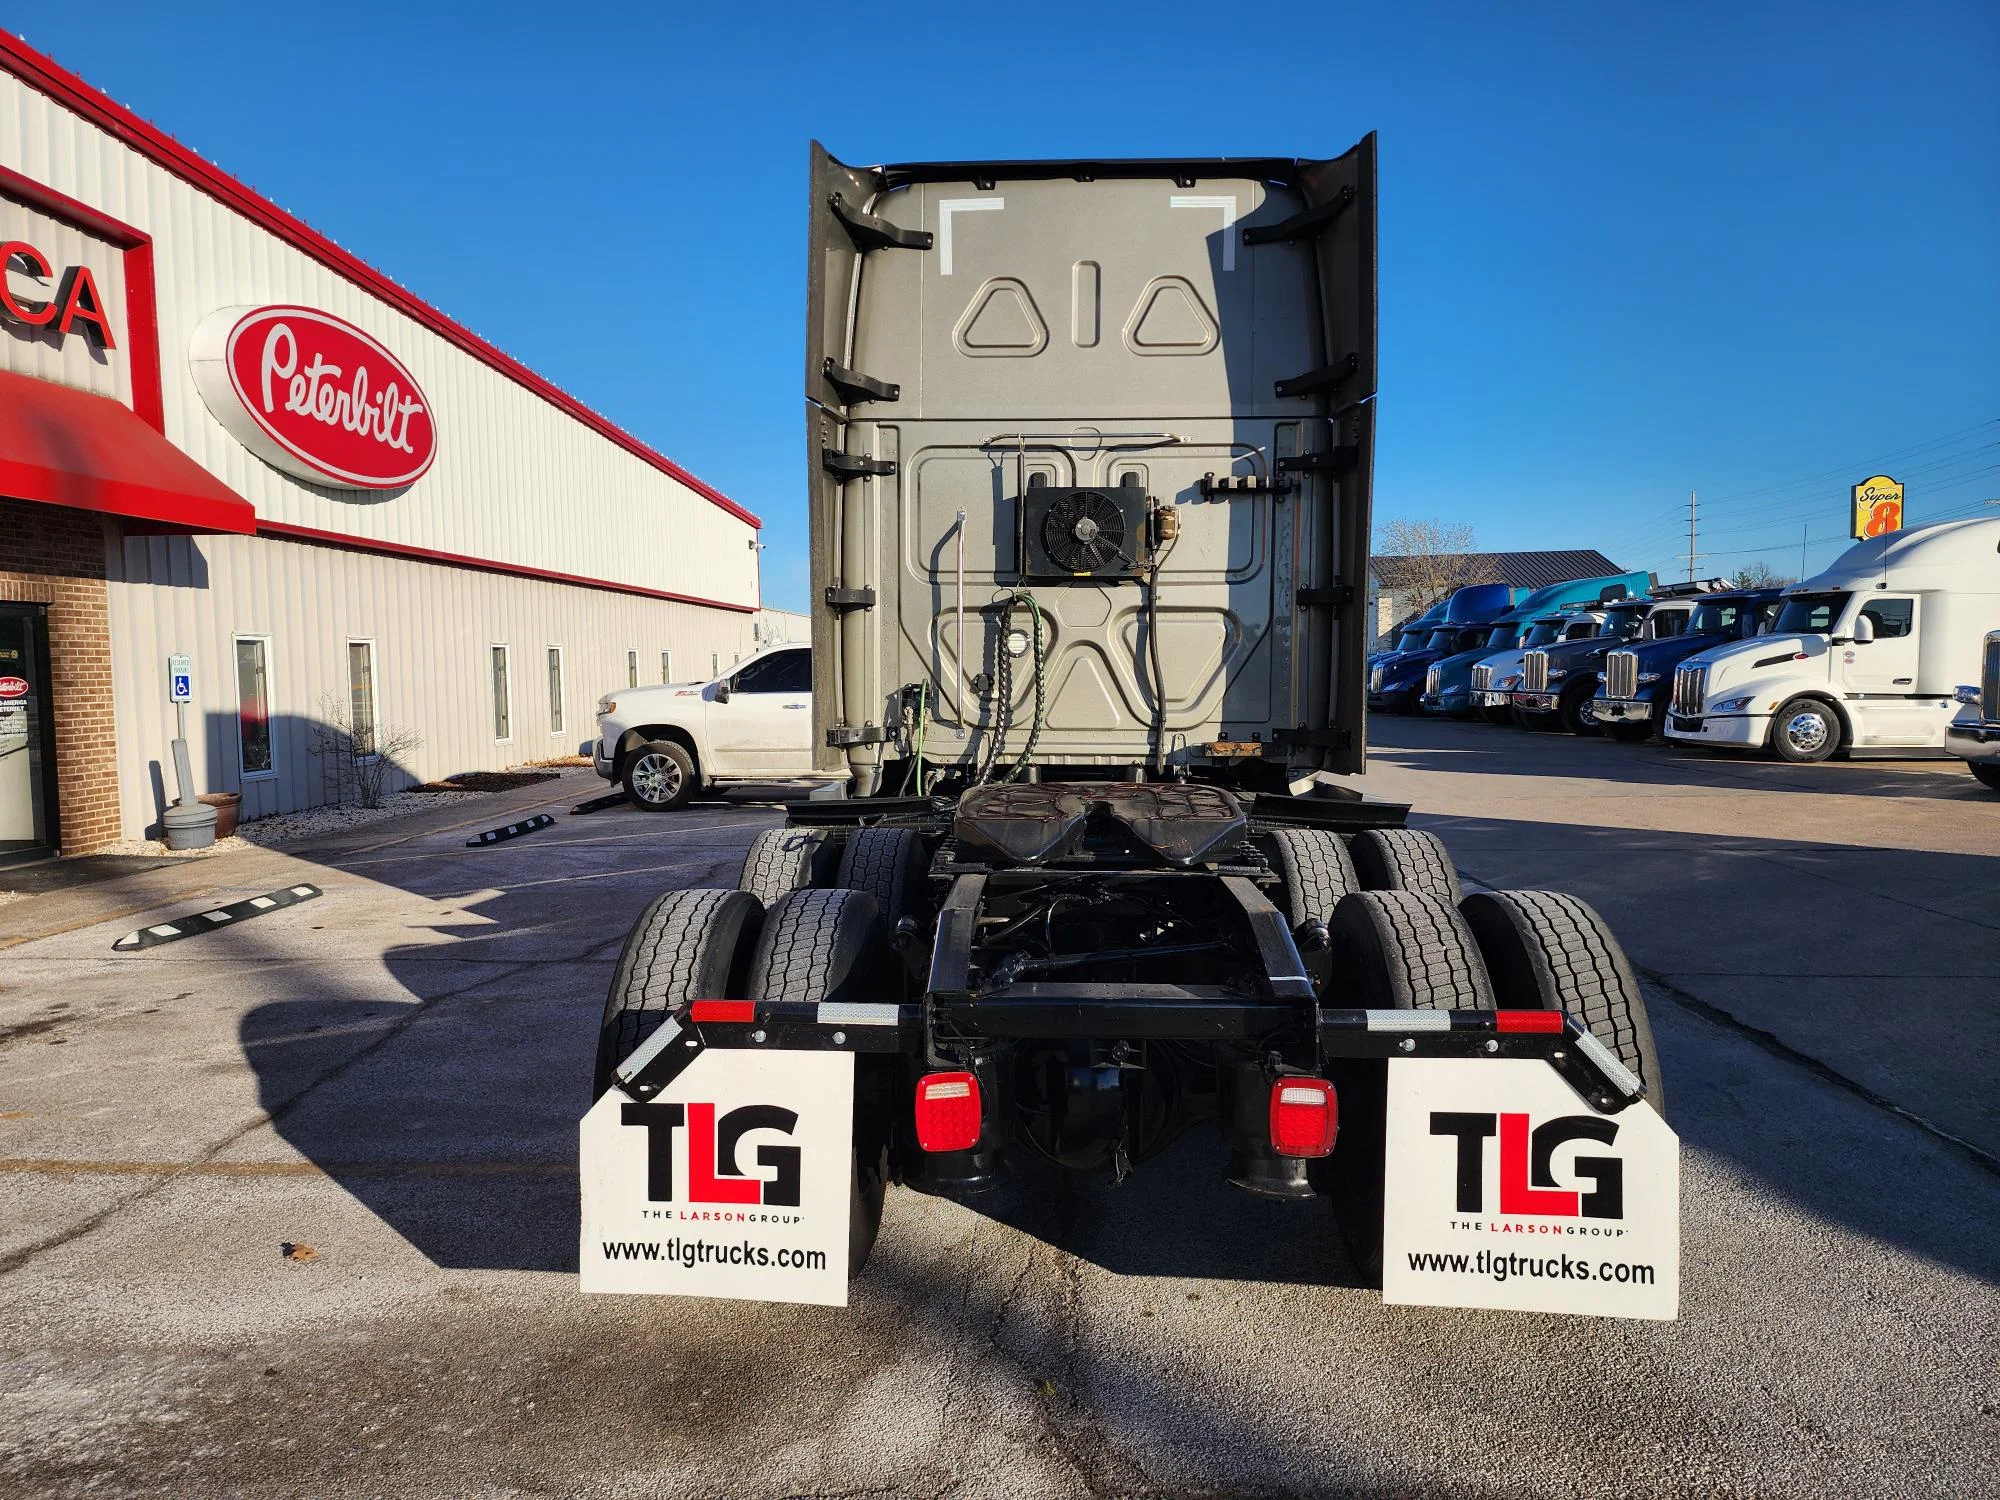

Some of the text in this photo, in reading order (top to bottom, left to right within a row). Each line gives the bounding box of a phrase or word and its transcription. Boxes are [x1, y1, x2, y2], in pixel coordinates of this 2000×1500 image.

[261, 322, 424, 454] Peterbilt
[1859, 486, 1901, 508] Super
[1864, 501, 1901, 538] 8
[620, 1102, 802, 1207] TLG
[1429, 1111, 1624, 1220] TLG
[641, 1210, 673, 1219] THE
[1450, 1221, 1483, 1231] THE
[602, 1237, 827, 1270] www.tlgtrucks.com
[1407, 1249, 1656, 1284] www.tlgtrucks.com
